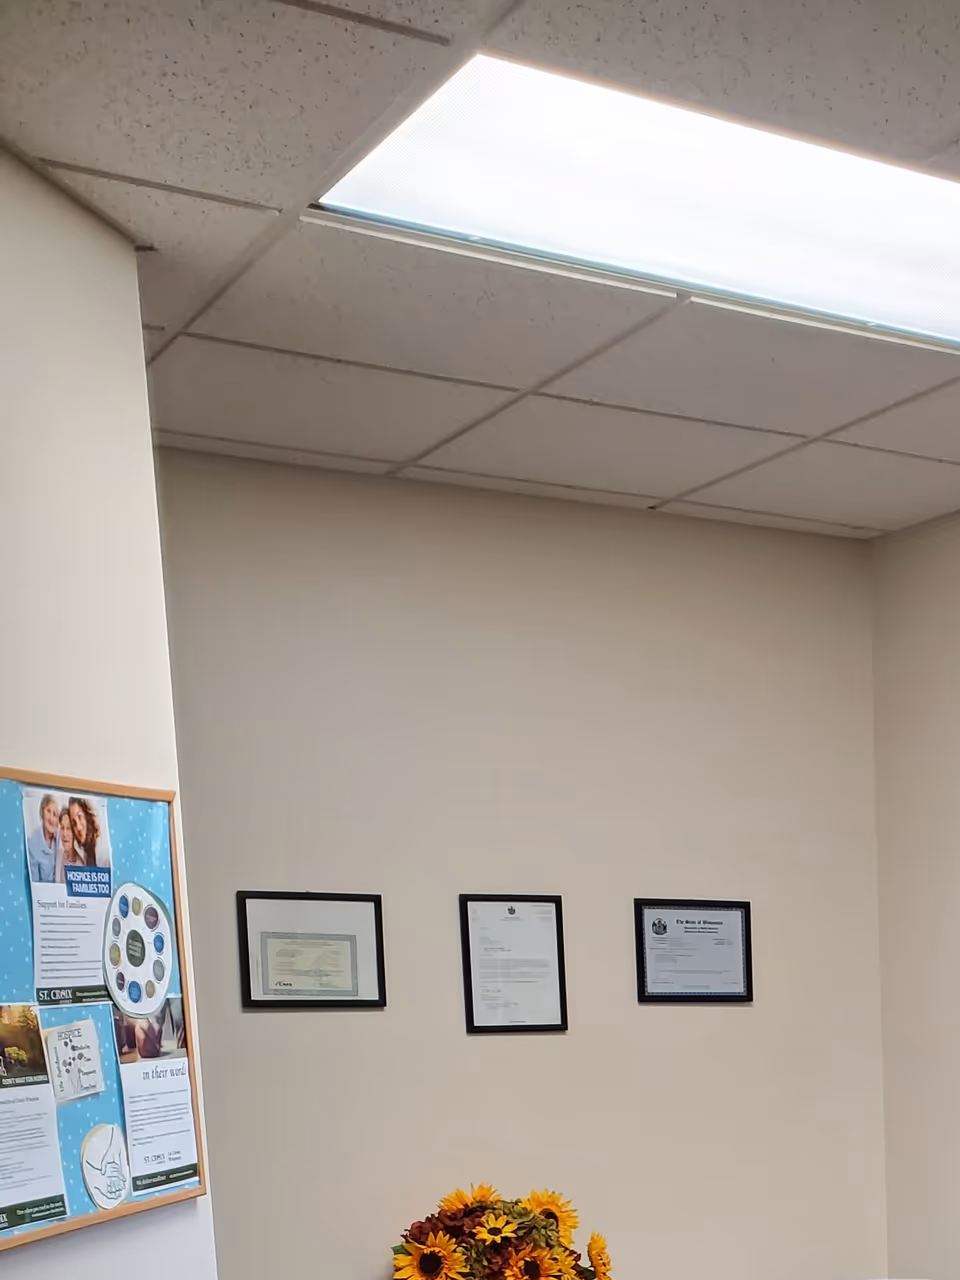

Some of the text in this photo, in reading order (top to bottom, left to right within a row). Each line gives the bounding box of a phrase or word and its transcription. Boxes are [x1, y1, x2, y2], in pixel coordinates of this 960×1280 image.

[67, 870, 109, 882] HOSPICE IS FOR
[72, 883, 109, 894] FAMILIES TOO
[50, 989, 73, 1000] CROIX
[151, 1065, 169, 1080] their
[169, 1062, 186, 1077] word
